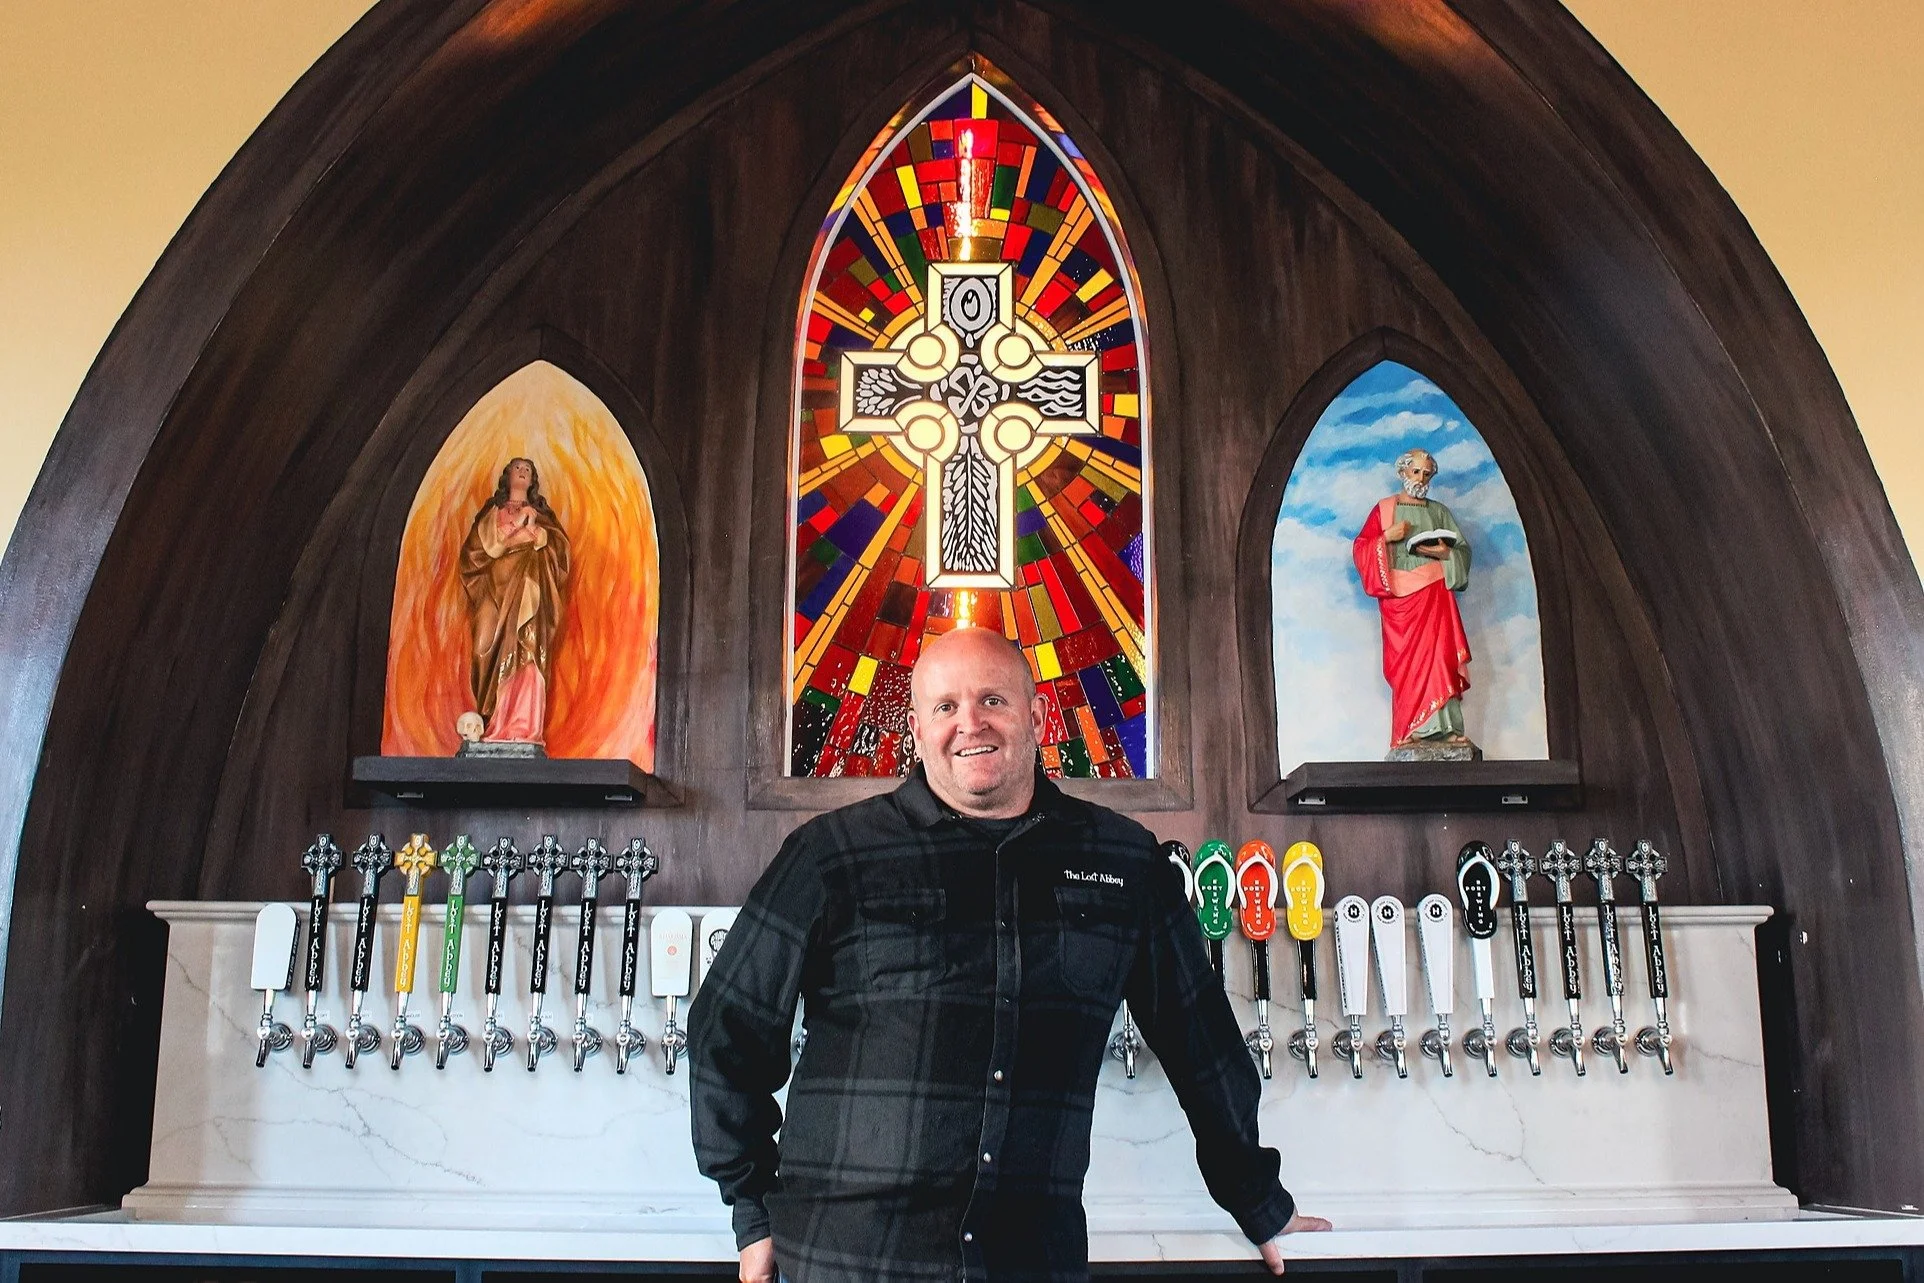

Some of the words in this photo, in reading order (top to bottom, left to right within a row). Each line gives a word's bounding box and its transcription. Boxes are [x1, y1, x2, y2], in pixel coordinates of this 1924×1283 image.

[1064, 870, 1080, 880] The
[1081, 871, 1098, 882] Lost
[1100, 873, 1124, 887] Abbey
